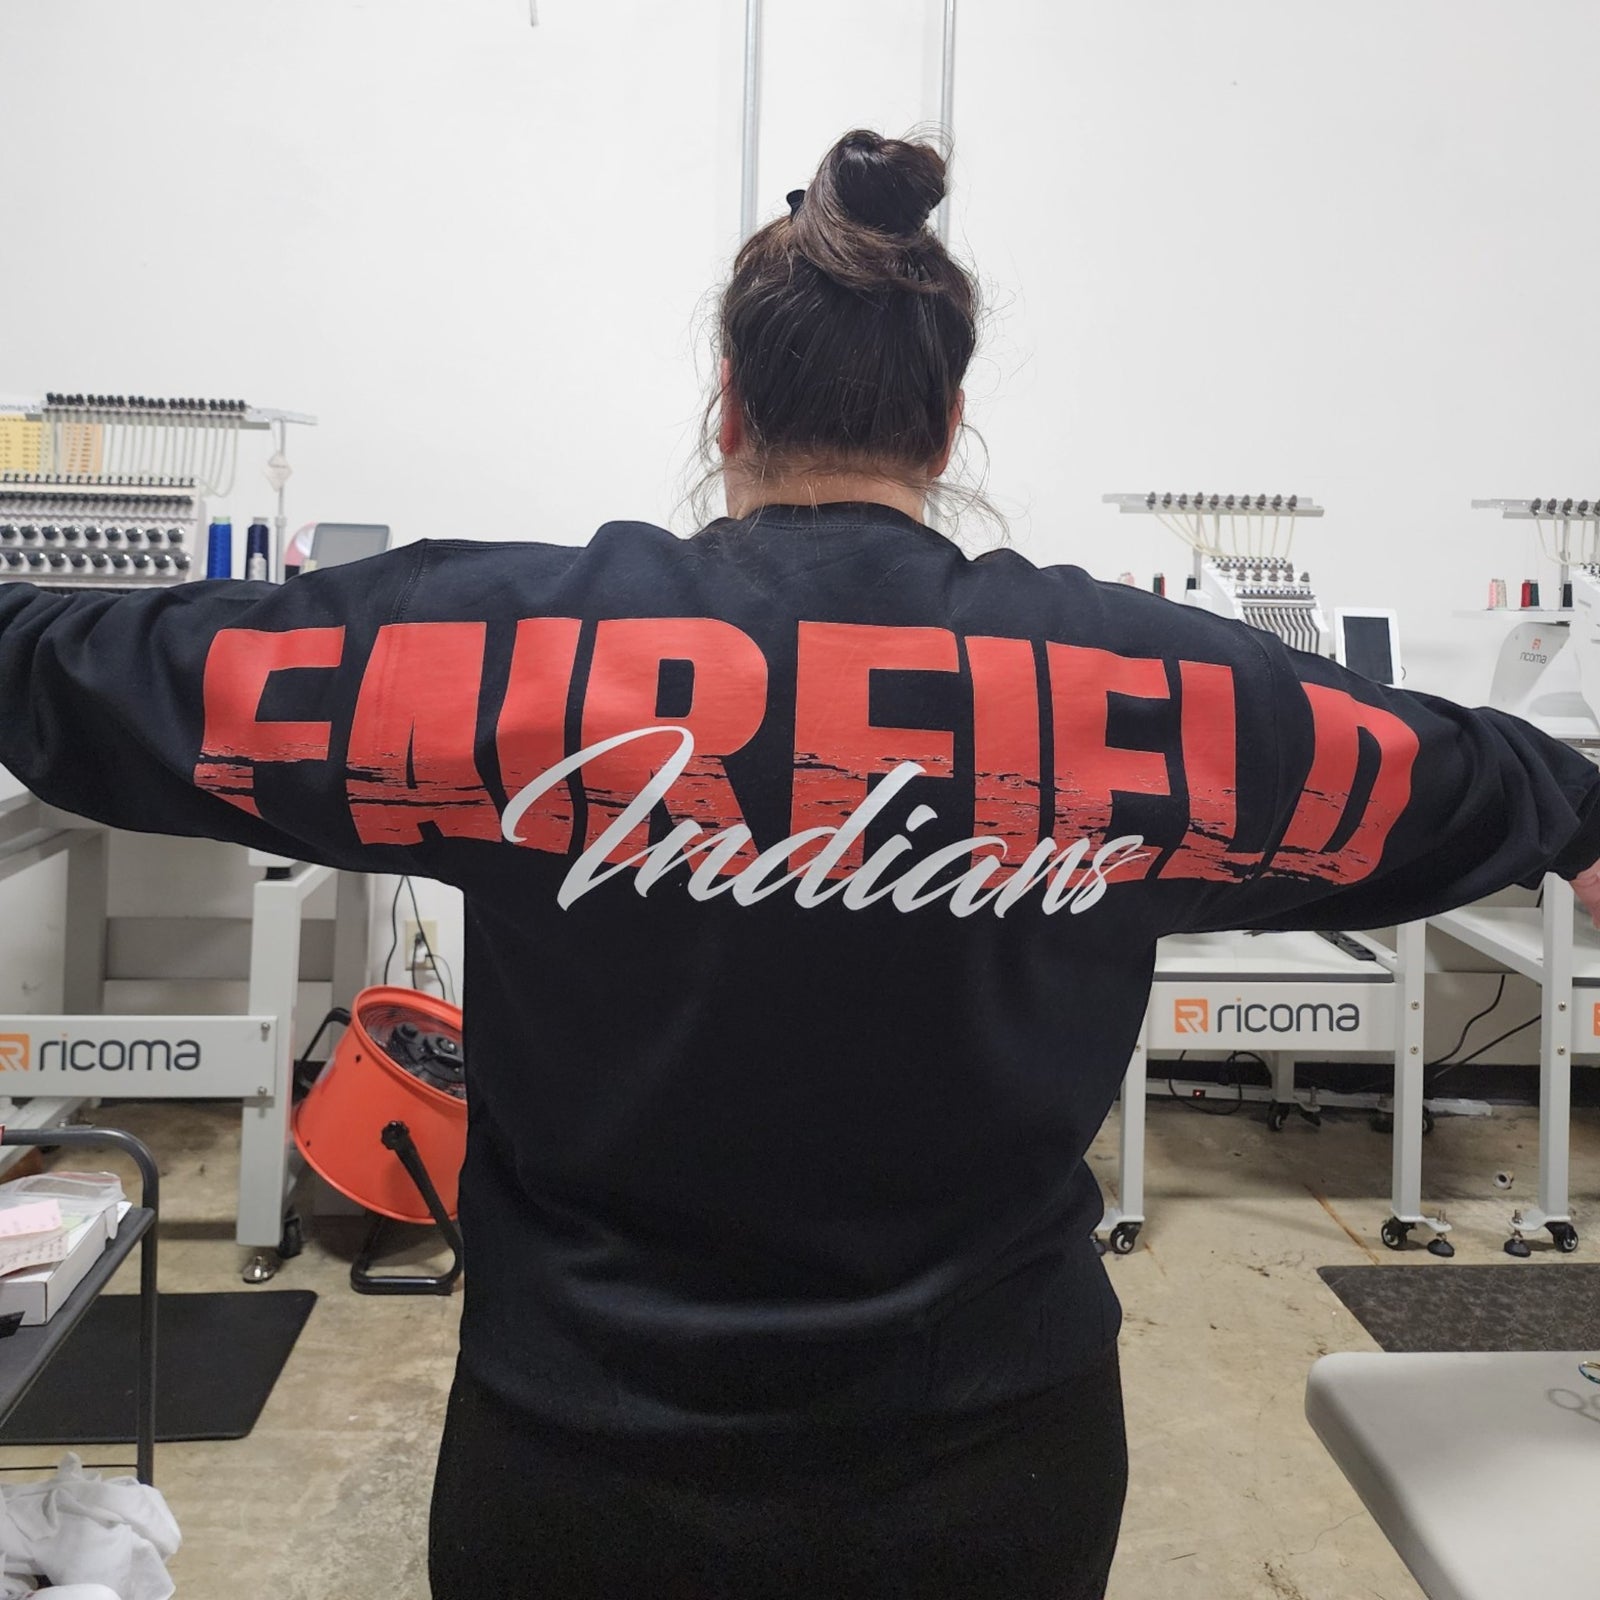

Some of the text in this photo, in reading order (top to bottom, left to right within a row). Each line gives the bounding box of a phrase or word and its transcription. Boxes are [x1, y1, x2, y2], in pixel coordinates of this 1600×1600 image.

[193, 617, 1421, 887] FAIRFIELD
[501, 726, 1151, 918] Indians
[39, 1033, 201, 1071] ricoma
[1217, 997, 1360, 1032] ricoma
